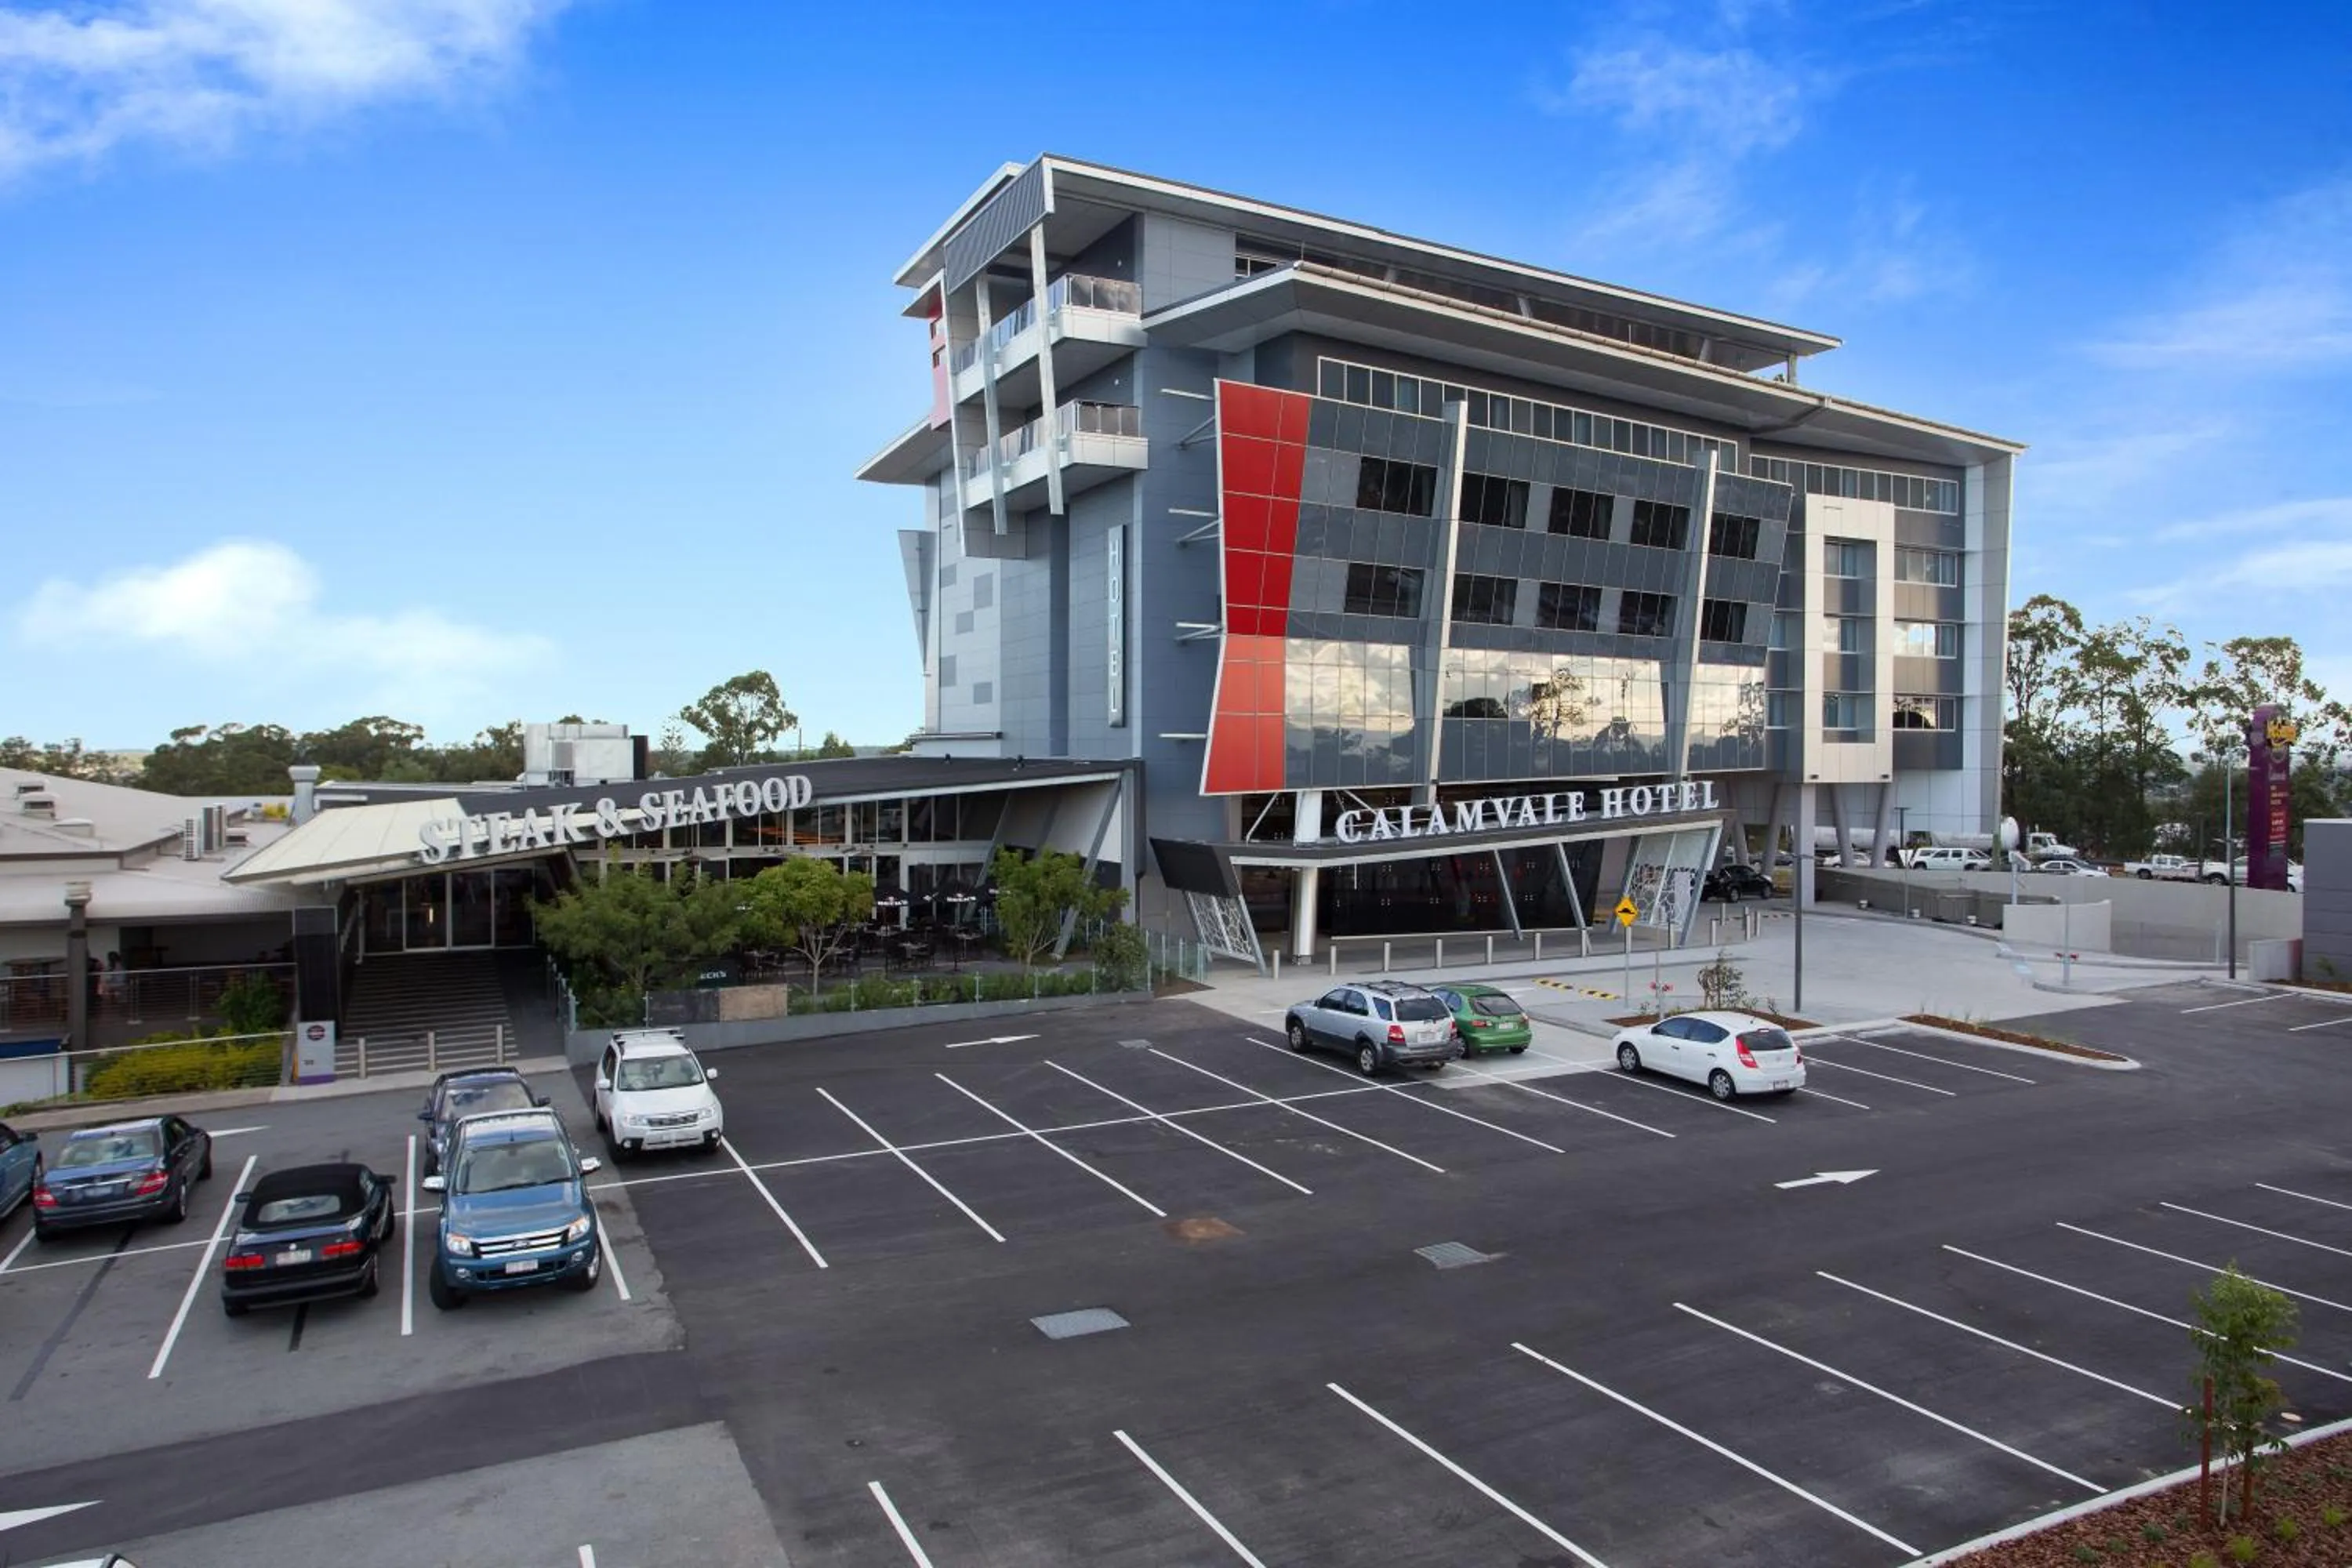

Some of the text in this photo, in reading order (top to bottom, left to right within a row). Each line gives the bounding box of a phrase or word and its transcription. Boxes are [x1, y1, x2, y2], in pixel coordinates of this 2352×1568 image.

[1109, 539, 1120, 713] HOTEL
[419, 775, 812, 865] STEAK & SEAFOOD
[1335, 779, 1720, 844] CALAMVALE HOTEL
